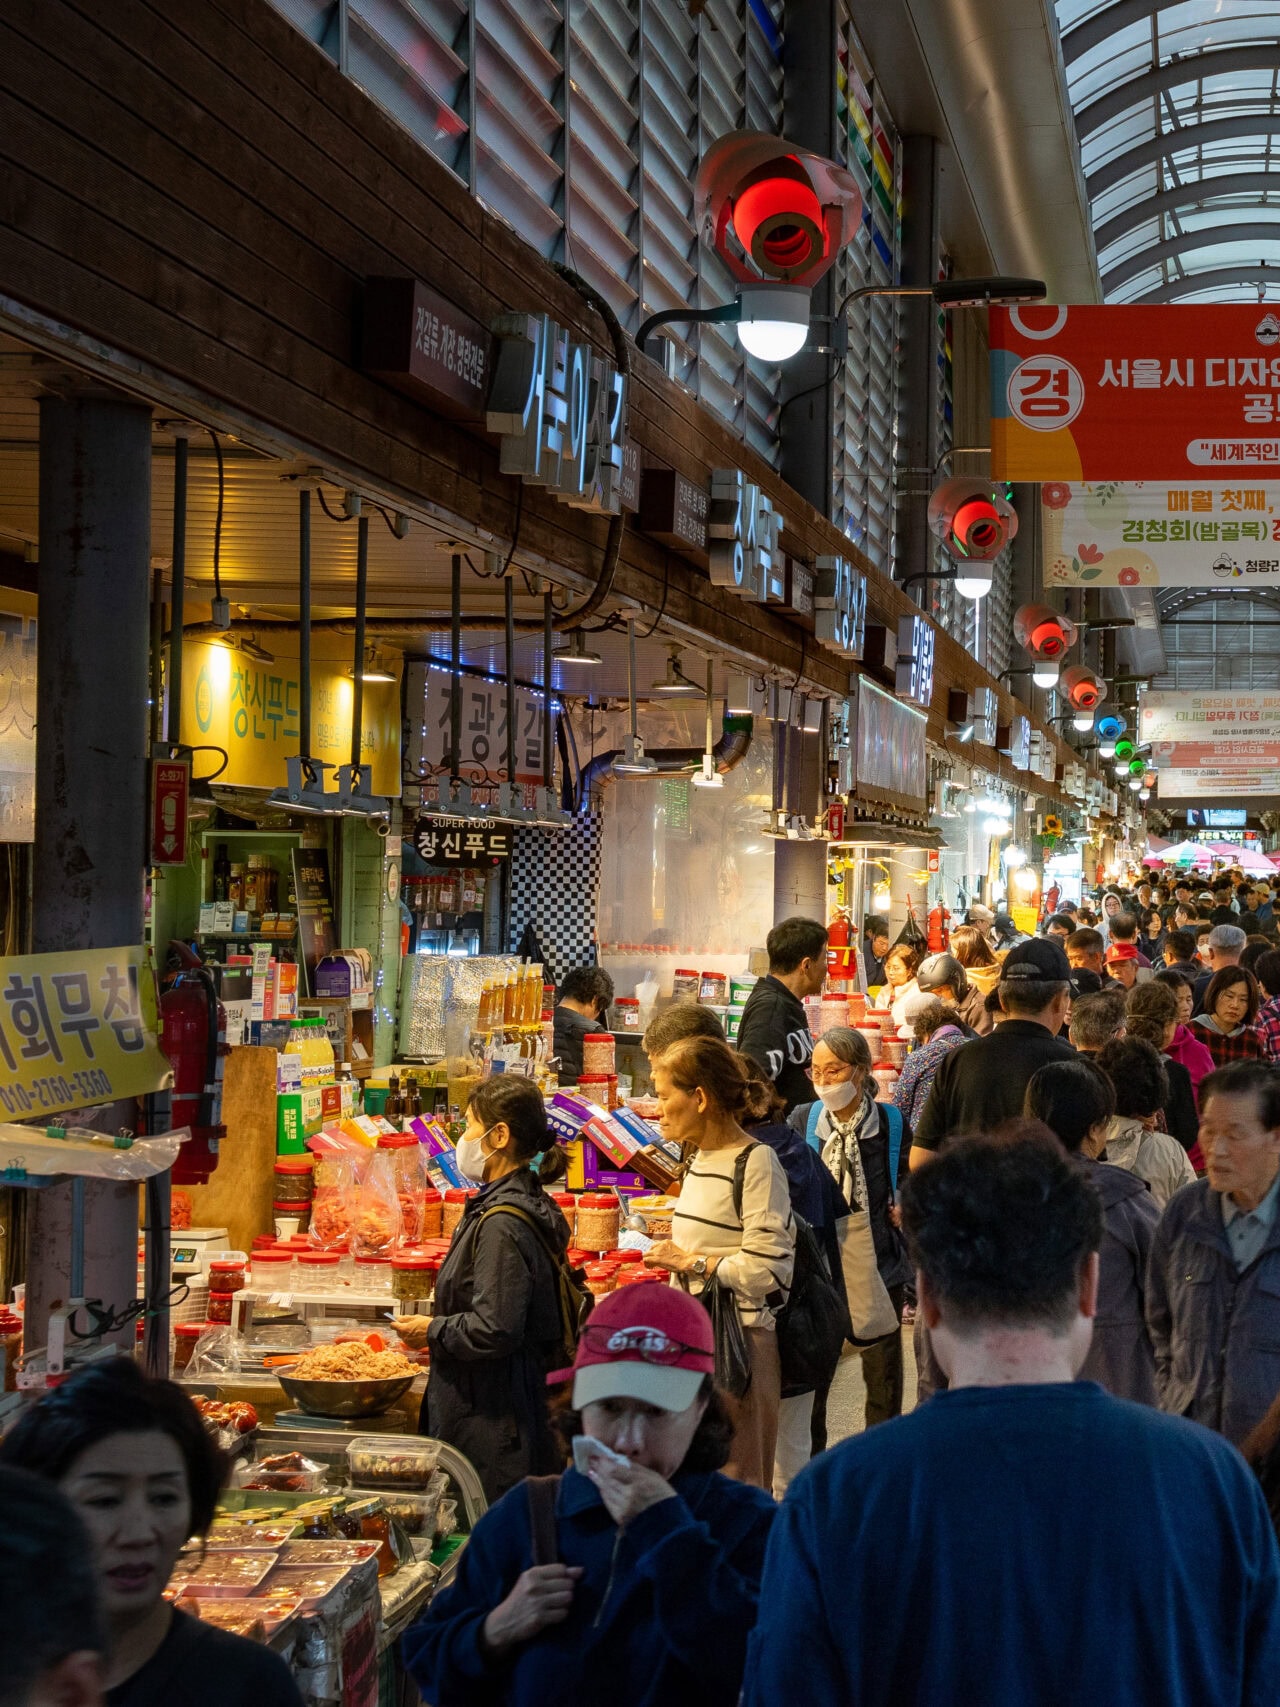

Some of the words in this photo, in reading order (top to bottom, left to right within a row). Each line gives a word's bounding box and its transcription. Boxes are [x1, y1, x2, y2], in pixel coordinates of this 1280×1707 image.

[1098, 359, 1194, 389] 서울시
[1020, 368, 1070, 417] 경
[1200, 443, 1279, 461] "세계적인
[1168, 489, 1213, 512] 매월
[1220, 488, 1274, 514] 첫째,
[1122, 519, 1268, 543] 경청회(밤골목)
[231, 666, 299, 742] 창신푸드
[159, 769, 184, 782] 소화기
[432, 818, 465, 830] SUPER
[467, 819, 496, 830] FOOD
[418, 832, 509, 859] 창신푸드
